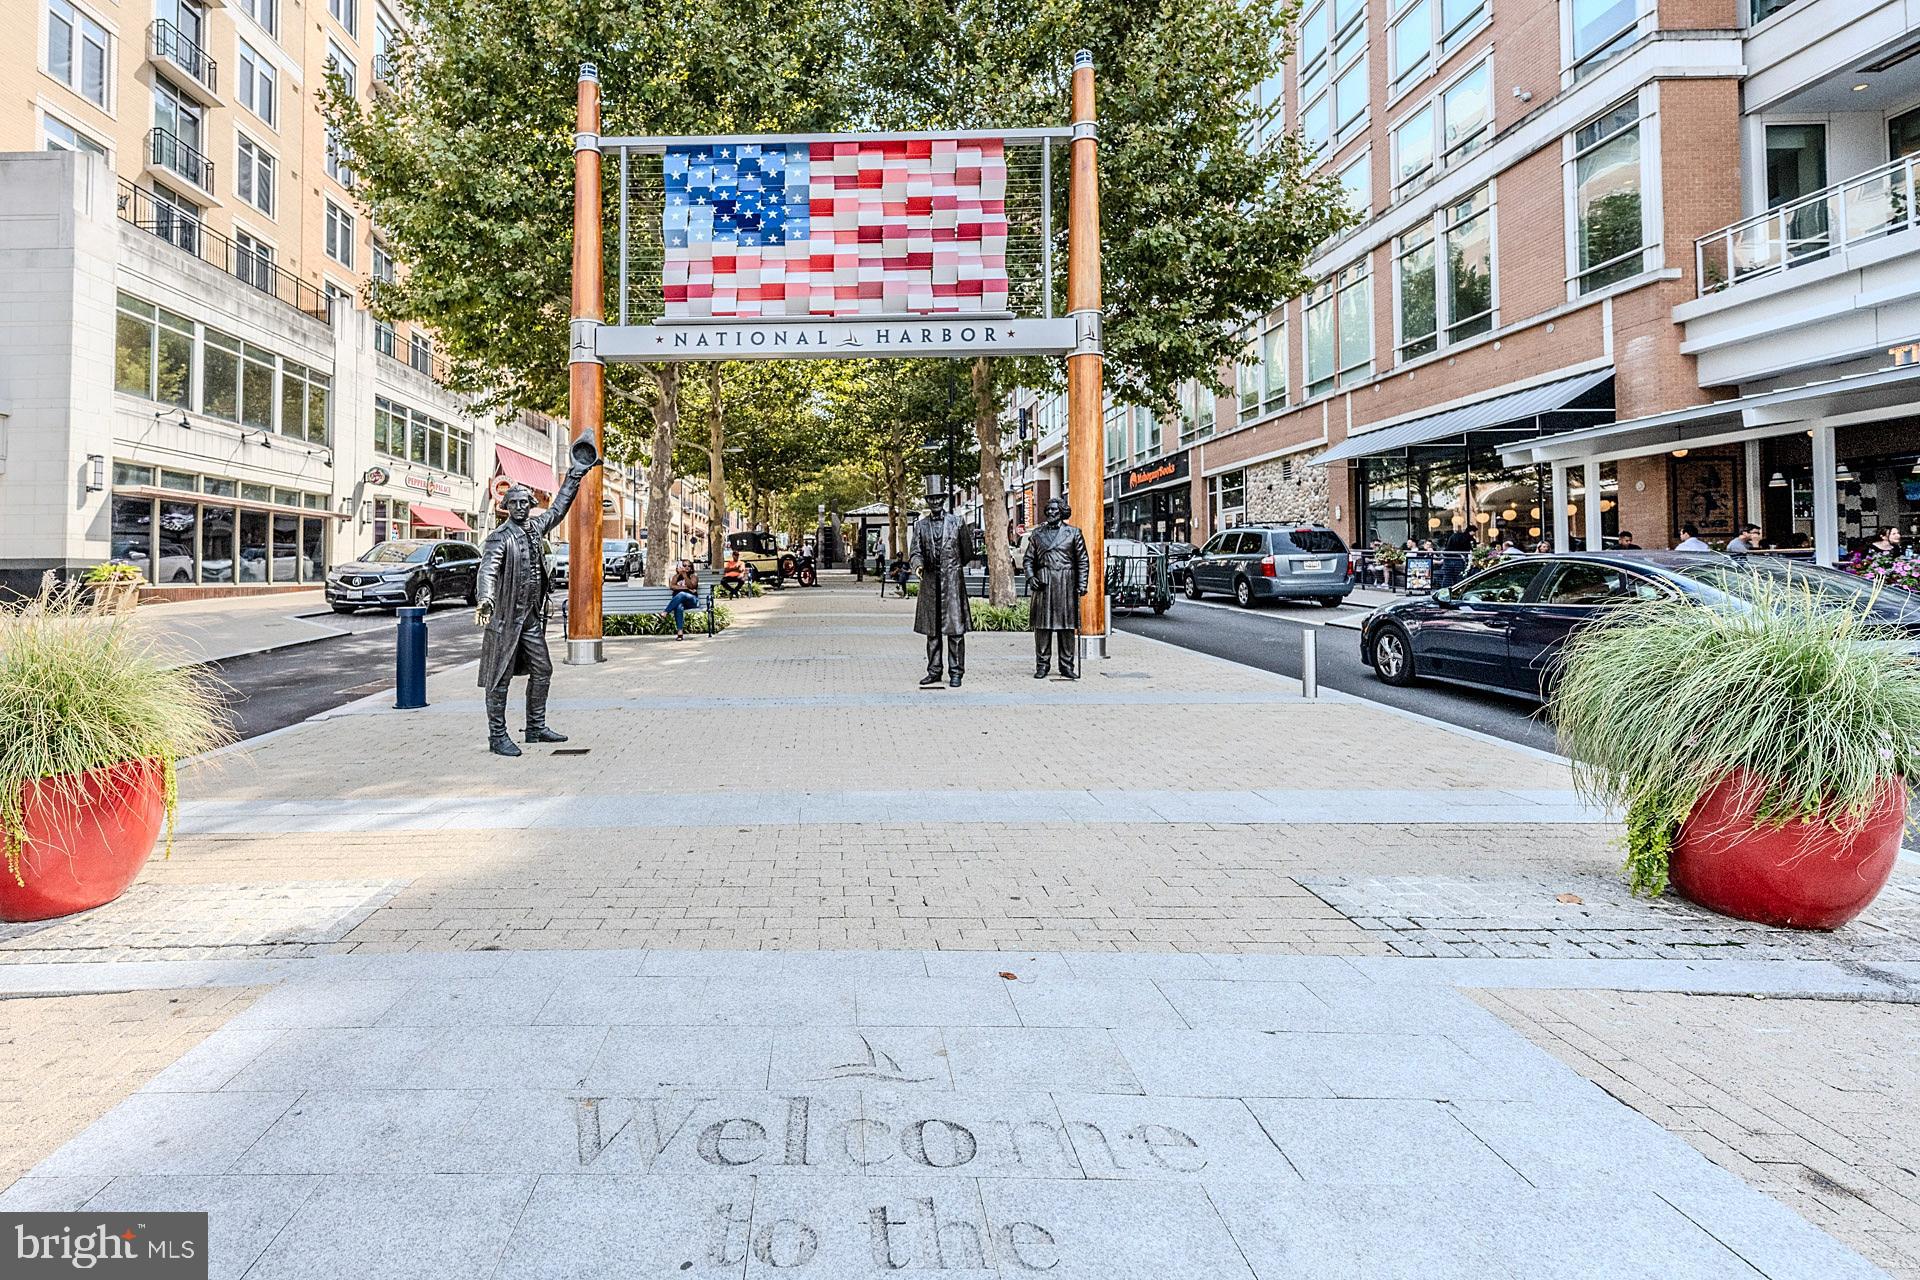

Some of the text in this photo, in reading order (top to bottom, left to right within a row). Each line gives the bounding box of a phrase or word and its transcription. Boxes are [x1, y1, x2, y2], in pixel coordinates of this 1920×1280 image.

[673, 327, 998, 347] NATIONAL HARBOR
[408, 476, 452, 495] PEPPER PALACE
[576, 1095, 1209, 1172] Welcome
[704, 1196, 1061, 1272] to the
